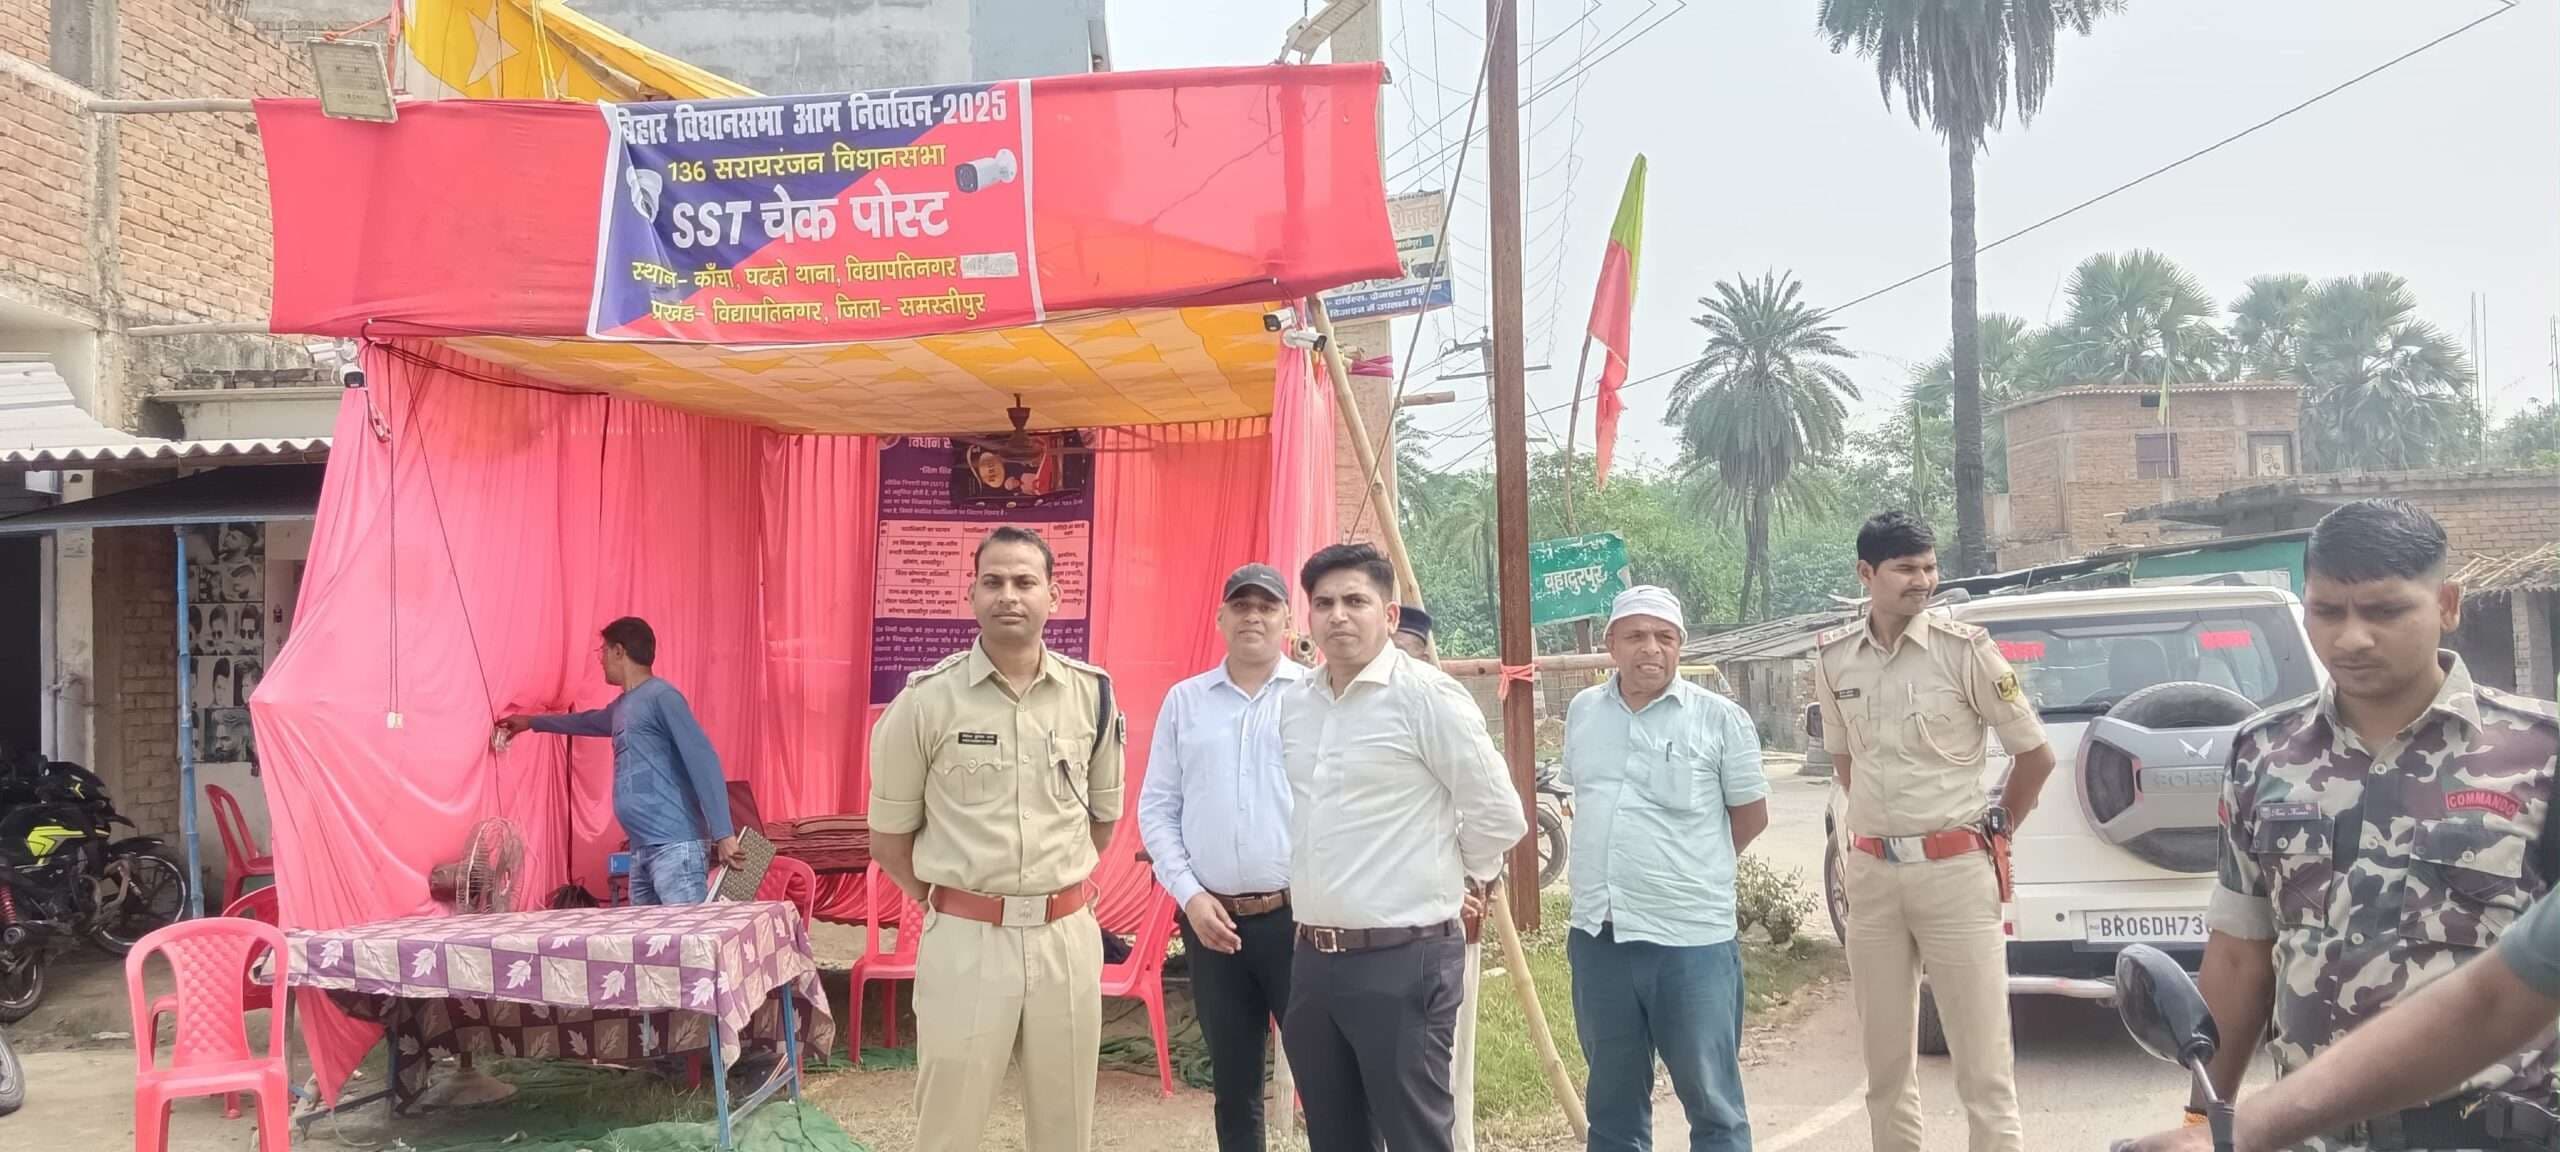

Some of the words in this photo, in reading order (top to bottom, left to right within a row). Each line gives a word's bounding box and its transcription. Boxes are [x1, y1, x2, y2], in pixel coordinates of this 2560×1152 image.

[616, 108, 668, 145] बिहार
[674, 104, 784, 142] विधानसभा
[793, 101, 841, 134] आम
[848, 89, 1007, 131] निर्वाचन-2025
[668, 161, 707, 182] 136
[712, 147, 825, 180] सरायरंजन
[832, 141, 946, 172] विधानसभा
[672, 200, 752, 249] SST
[760, 184, 839, 243] चेक
[849, 178, 950, 239] पोस्ट
[632, 261, 688, 288] स्थान-
[744, 259, 788, 287] घटहो
[796, 263, 841, 287] थाना,
[845, 252, 957, 282] विद्यापतिनगर
[651, 299, 705, 323] प्रखंड-
[712, 296, 829, 324] विद्यापतिनगर,
[835, 293, 892, 320] जिला-
[898, 287, 986, 320] समस्तीपुर
[2449, 791, 2517, 816] COMMANDO
